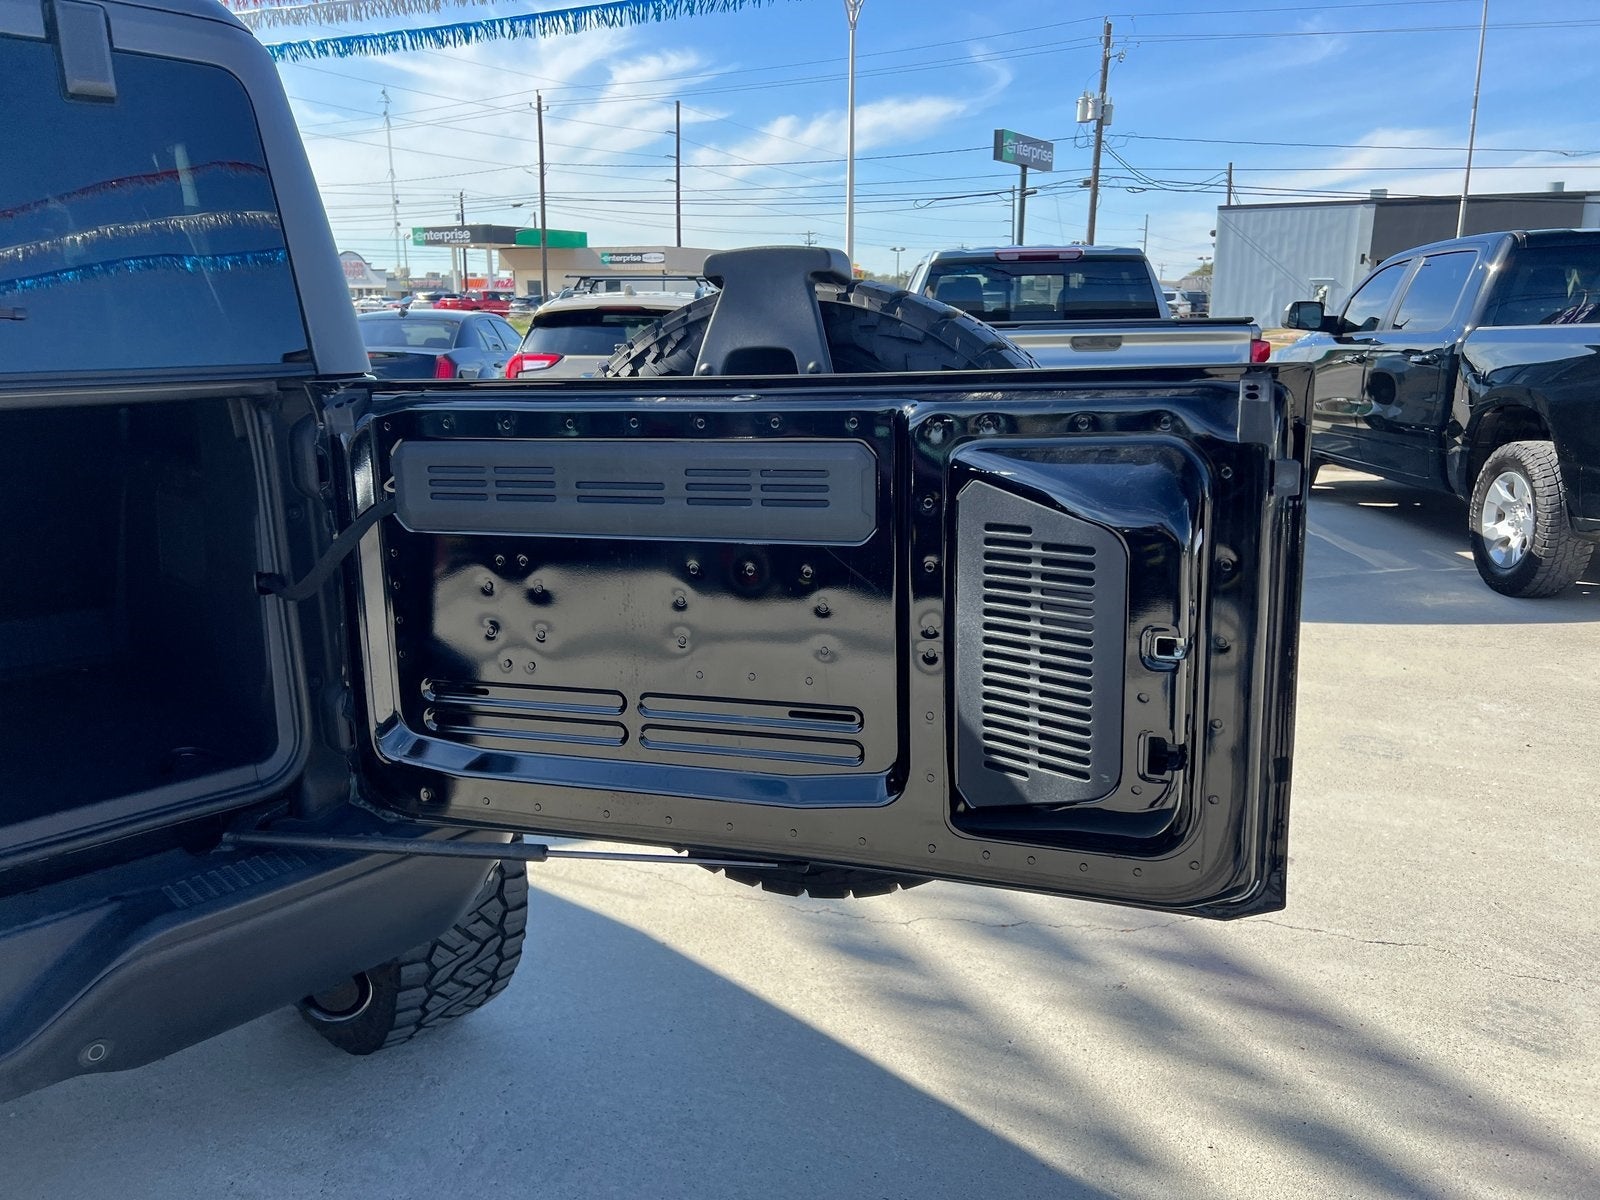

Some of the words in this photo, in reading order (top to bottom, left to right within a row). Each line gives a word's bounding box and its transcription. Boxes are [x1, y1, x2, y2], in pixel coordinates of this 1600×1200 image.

[1003, 139, 1053, 163] enterprise
[415, 228, 471, 242] enterprise
[601, 254, 642, 263] enterprise
